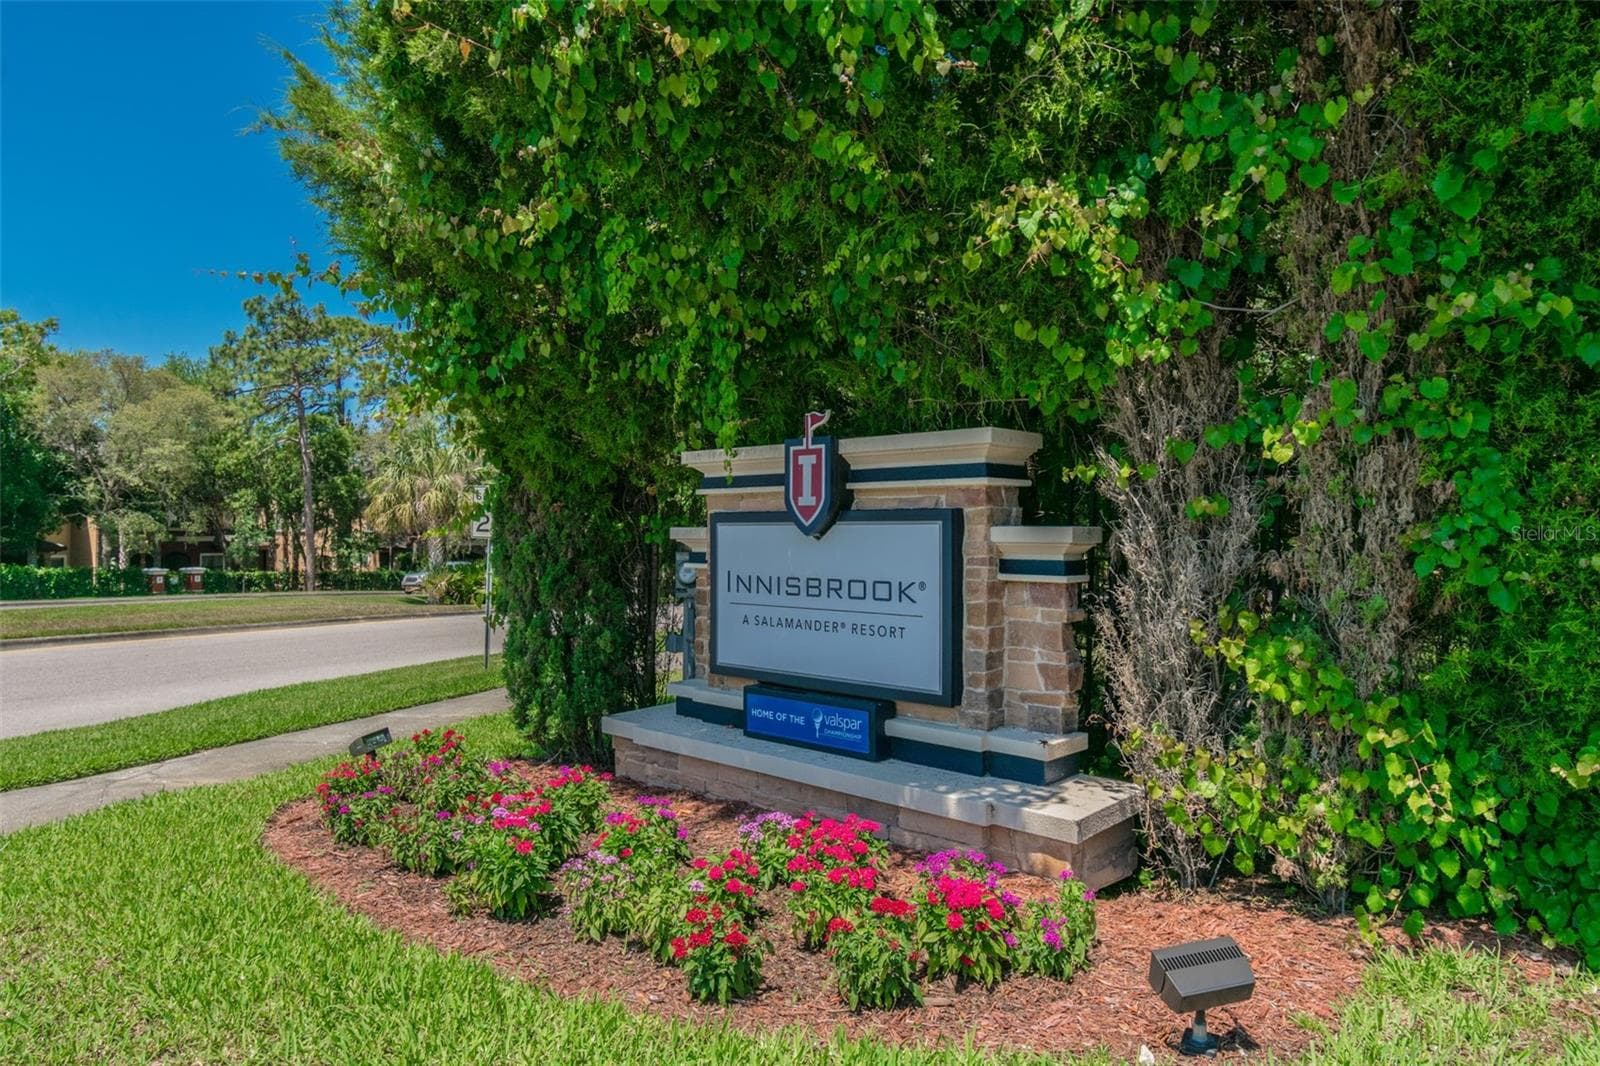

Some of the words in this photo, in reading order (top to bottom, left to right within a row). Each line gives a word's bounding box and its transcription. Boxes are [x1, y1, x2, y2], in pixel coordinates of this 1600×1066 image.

[742, 614, 750, 626] A
[851, 622, 907, 640] RESORT
[751, 707, 774, 721] HOME
[775, 711, 788, 722] OF
[790, 713, 806, 726] THE
[823, 712, 863, 732] valspar
